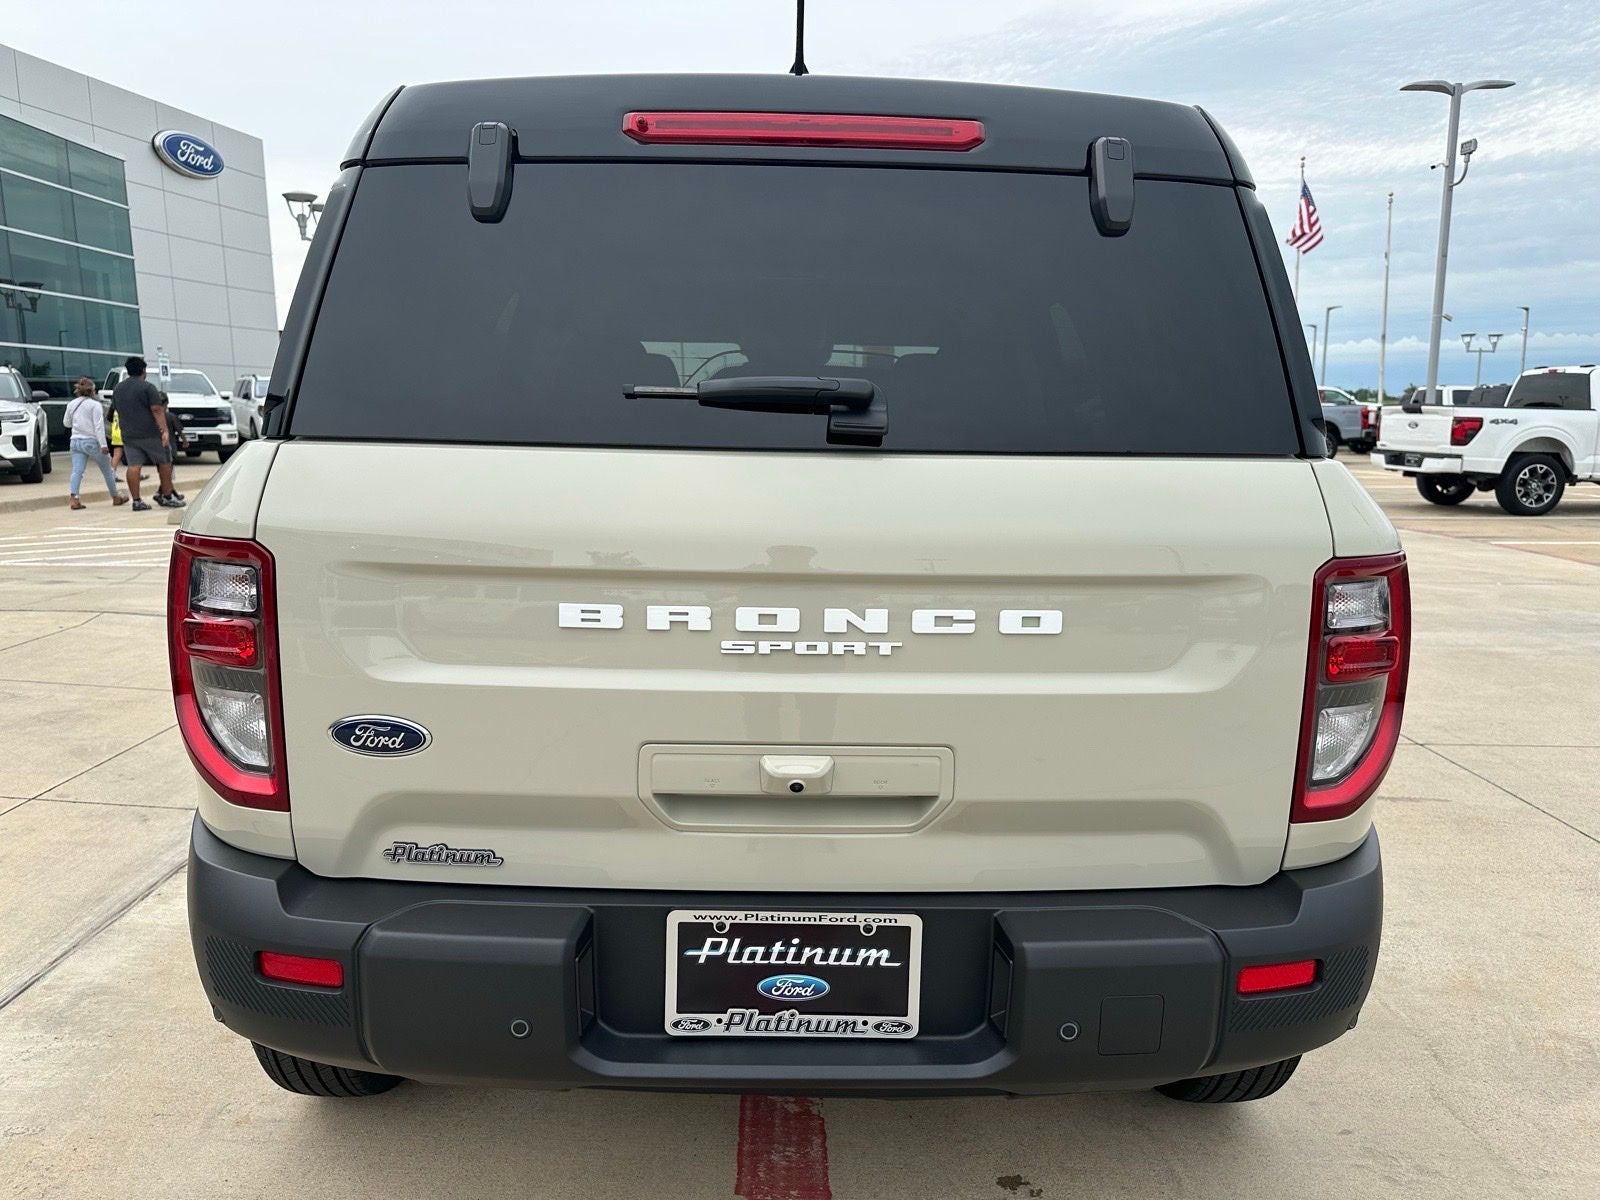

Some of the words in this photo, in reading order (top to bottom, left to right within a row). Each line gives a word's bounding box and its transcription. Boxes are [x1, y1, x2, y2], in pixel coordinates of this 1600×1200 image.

[177, 140, 214, 170] Ford
[558, 602, 1063, 635] BRONCO
[720, 640, 903, 656] SPORT
[350, 724, 404, 749] Ford
[384, 841, 504, 867] Platinum
[693, 912, 898, 925] www.PlatinumFord.com
[684, 937, 902, 966] Platinum
[771, 977, 814, 997] Ford
[677, 1019, 705, 1031] Ford
[721, 1010, 868, 1035] Platinum
[878, 1021, 905, 1034] Ford
